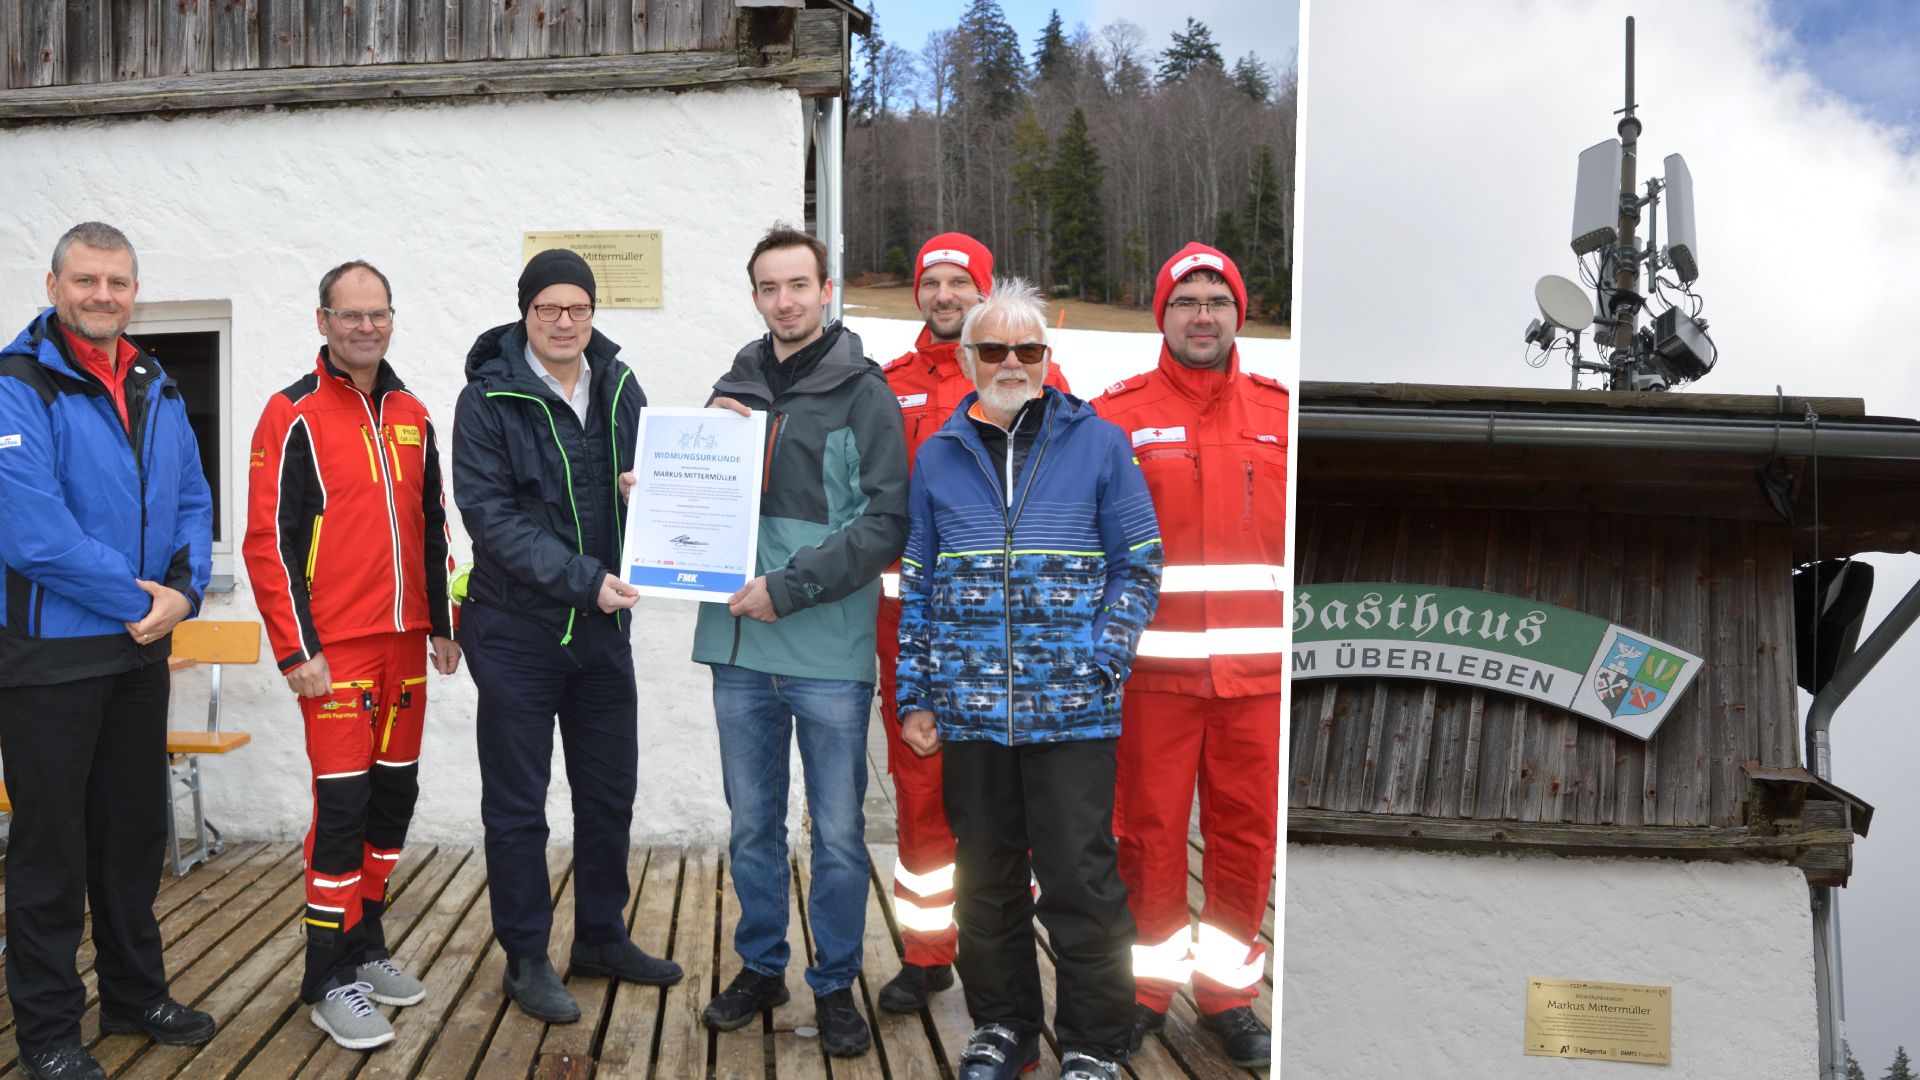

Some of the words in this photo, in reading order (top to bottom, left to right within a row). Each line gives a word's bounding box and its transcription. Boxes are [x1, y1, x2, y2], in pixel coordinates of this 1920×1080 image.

[582, 252, 644, 261] Mittermüller
[654, 451, 742, 463] WIDMUNGSURKUNDE
[653, 470, 683, 479] MARKUS
[684, 471, 737, 482] MITTERMÜLLER
[677, 572, 698, 583] FMK
[1335, 642, 1555, 694] ÜBERLEBEN
[1547, 999, 1585, 1011] Markus
[1588, 1002, 1651, 1015] Mittermüller
[1580, 1047, 1607, 1055] Magenta
